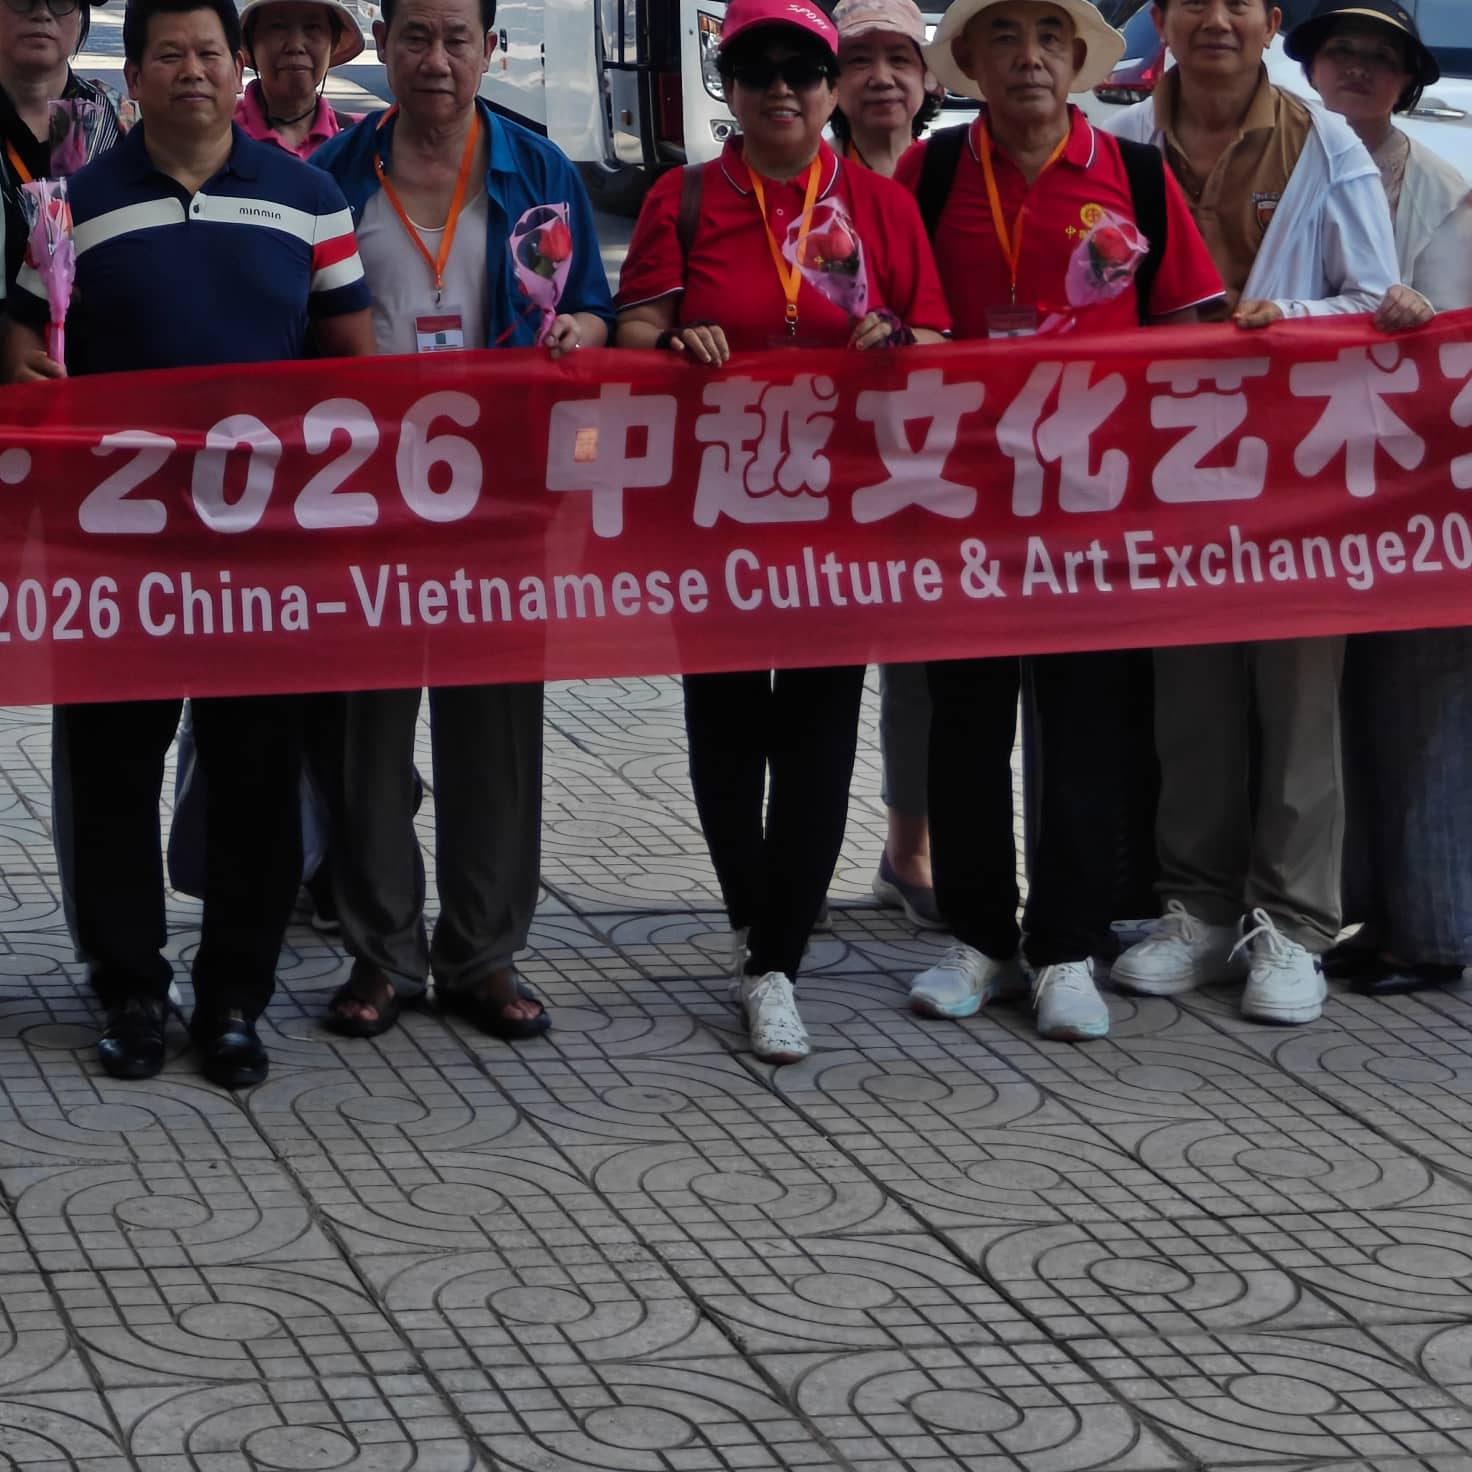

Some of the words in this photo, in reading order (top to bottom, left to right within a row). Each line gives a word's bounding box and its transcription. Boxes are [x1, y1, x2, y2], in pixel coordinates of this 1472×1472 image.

[78, 390, 483, 536] 2026
[724, 546, 943, 611] Culture
[959, 538, 1004, 599] &
[1022, 536, 1113, 597] Art
